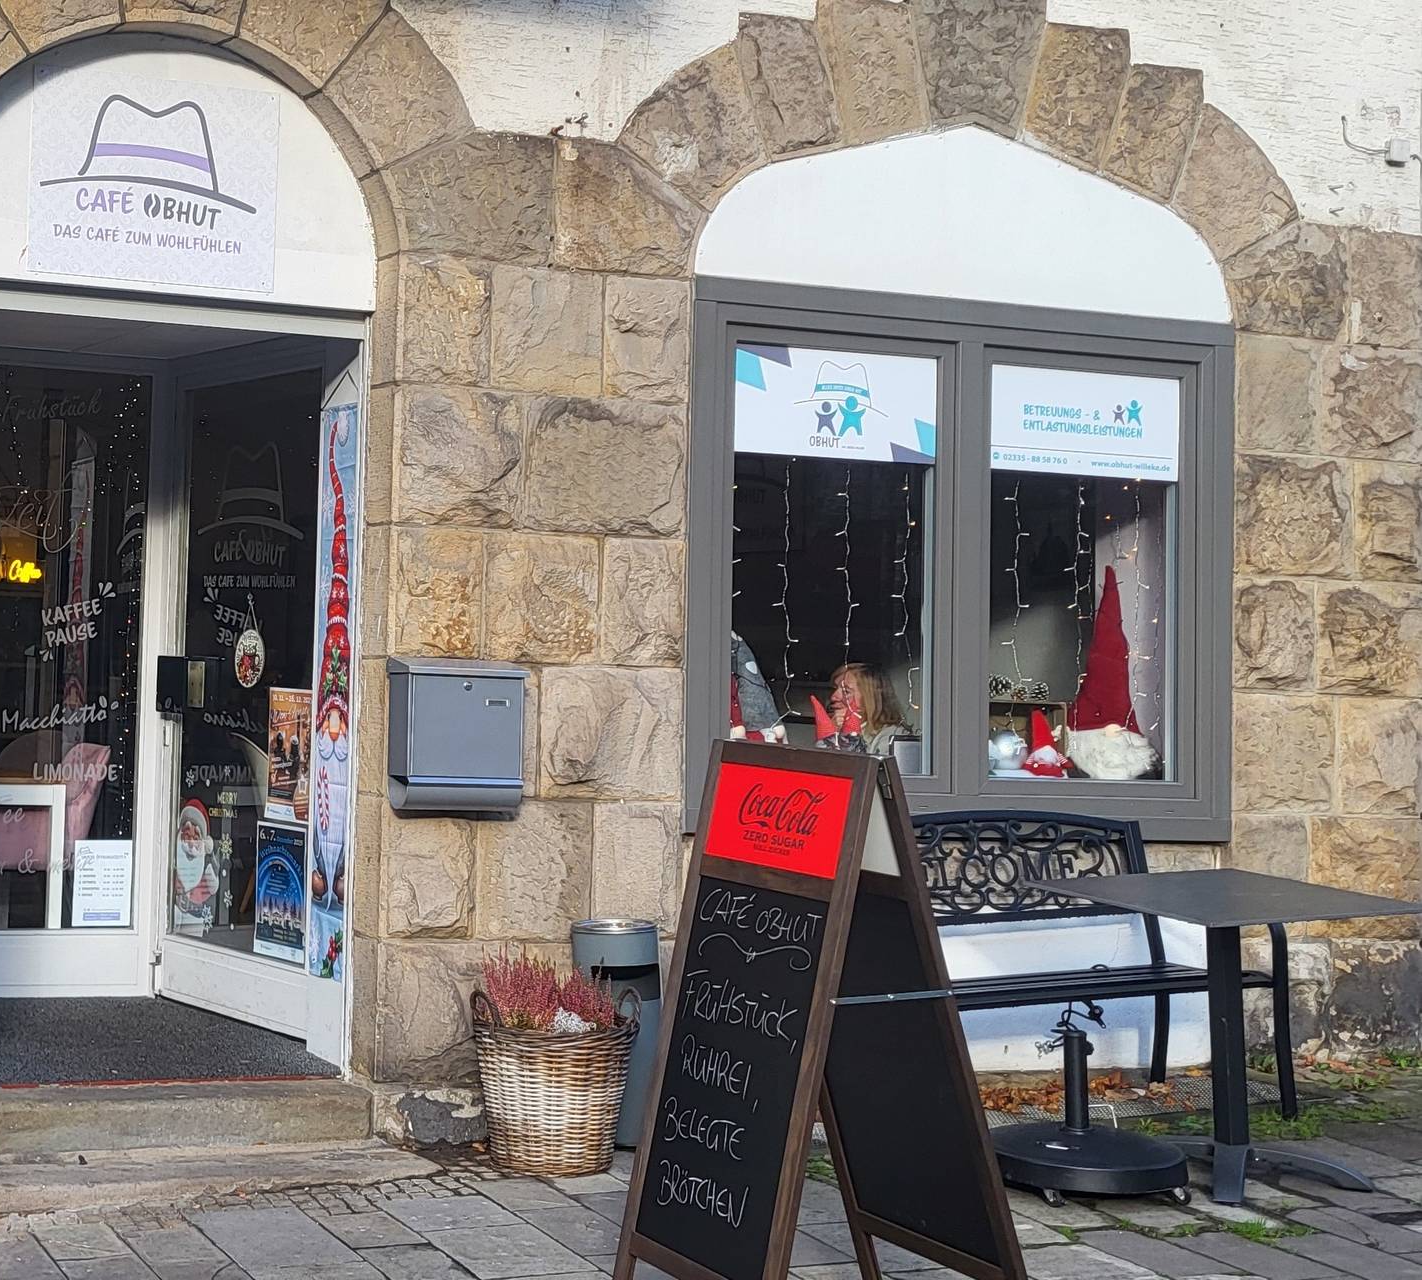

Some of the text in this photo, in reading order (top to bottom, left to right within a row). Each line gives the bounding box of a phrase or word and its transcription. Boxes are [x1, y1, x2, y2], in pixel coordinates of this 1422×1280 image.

[76, 187, 134, 214] CAFÉ
[53, 223, 242, 254] DAS CAFÉ ZUM WOHLFÜHLEN
[2, 388, 103, 423] Frühstück
[1023, 403, 1082, 419] BETREUUNGS
[809, 435, 841, 448] OBHUT
[1023, 419, 1143, 439] ENTLASTUNGSLEISTUNGEN
[41, 598, 103, 627] KAFFEE
[45, 621, 98, 648] PAUSE
[33, 763, 118, 782] LIMONADE
[217, 791, 238, 805] MERRY
[739, 783, 828, 837] Coca-Cola
[209, 807, 238, 818] CHRISTMAS
[743, 829, 806, 850] ZERO SUGAR
[18, 848, 39, 874] &
[700, 887, 823, 942] CAFÉ OBHUT
[664, 1096, 746, 1160] BELEGTE
[657, 1160, 750, 1228] BRÖTCHEN
